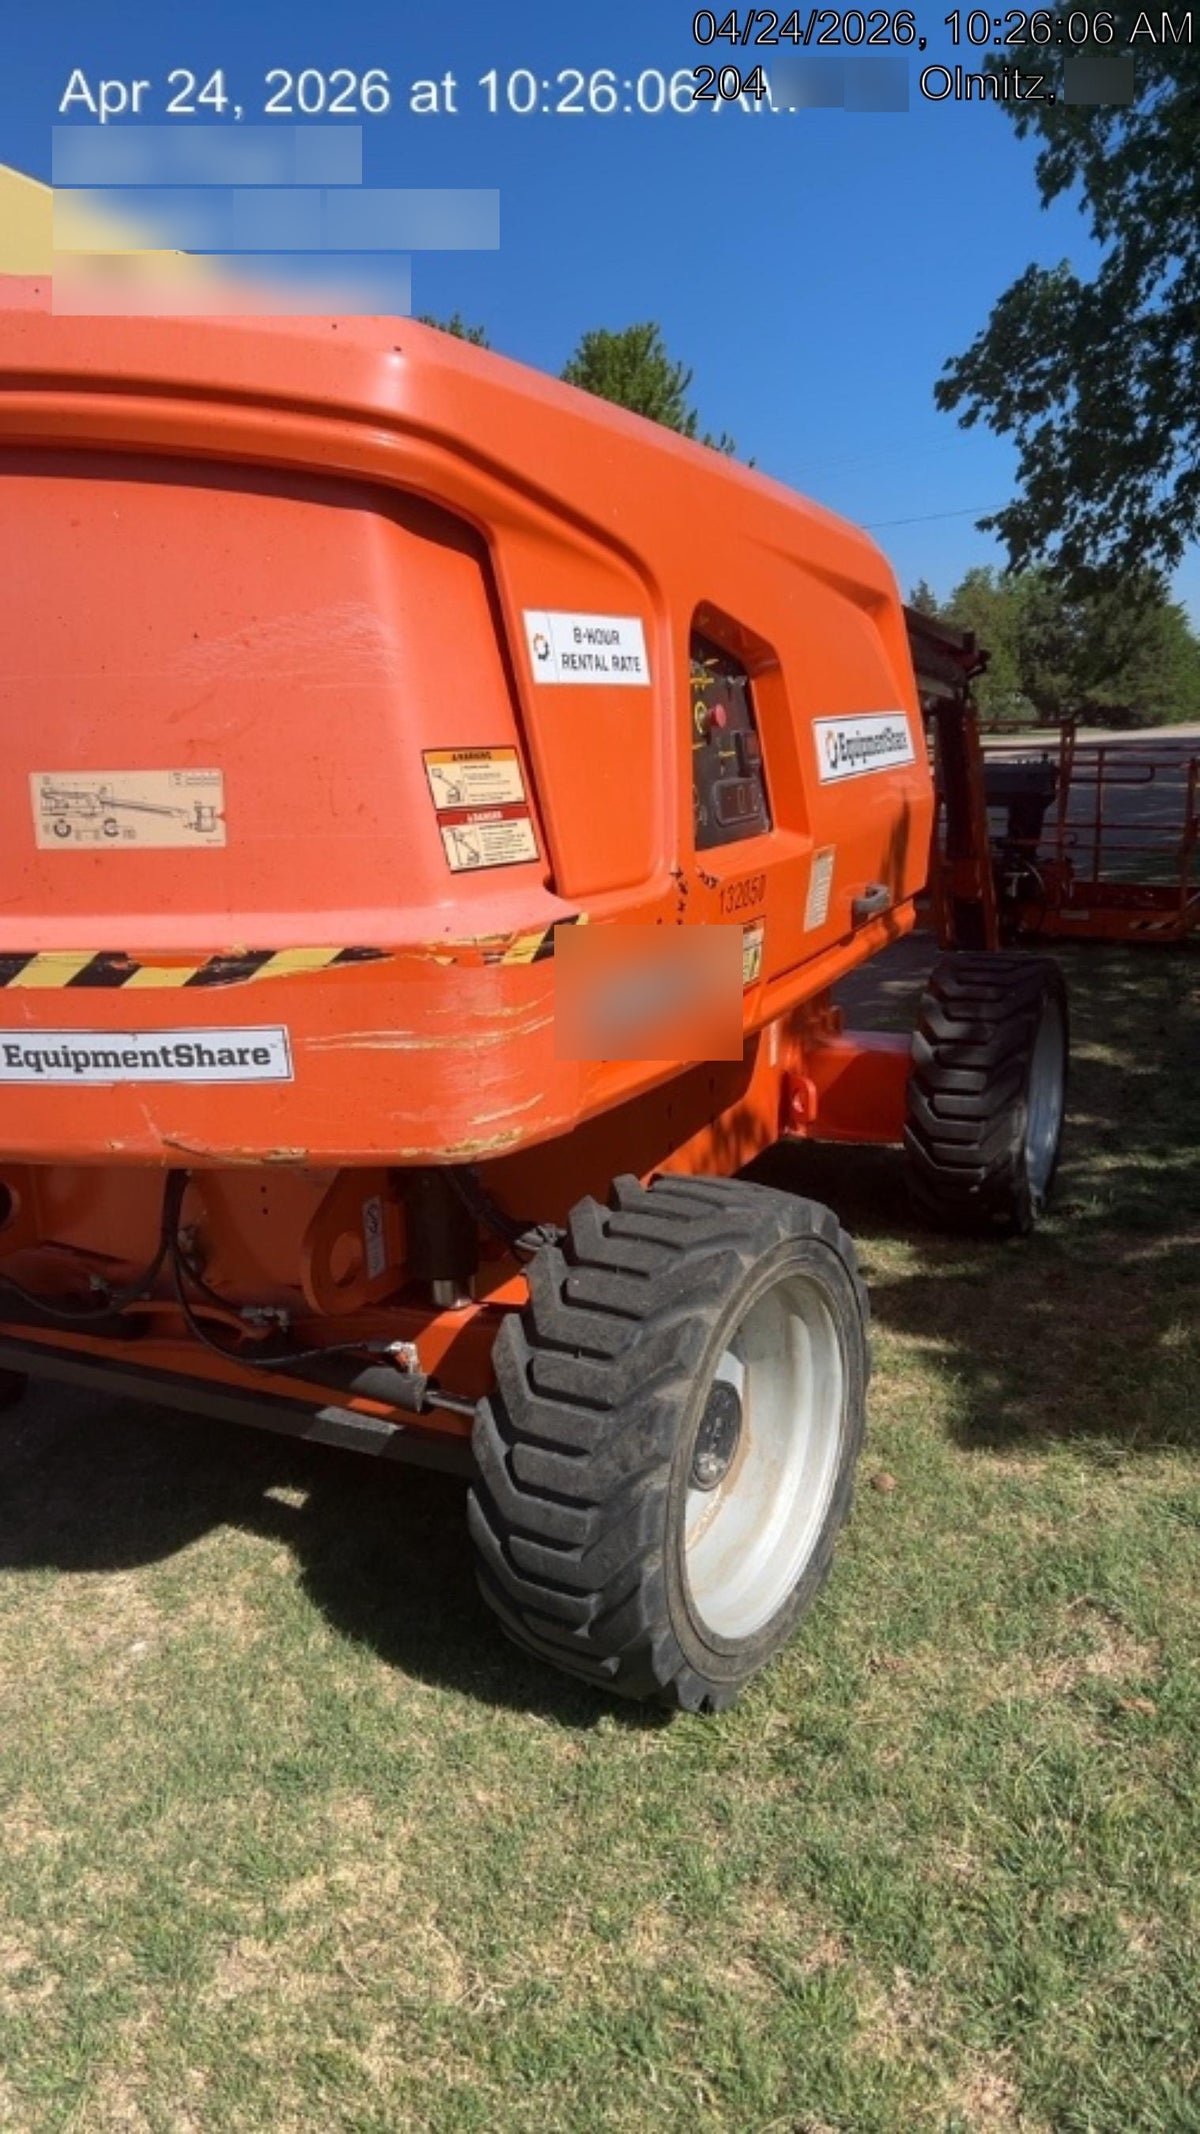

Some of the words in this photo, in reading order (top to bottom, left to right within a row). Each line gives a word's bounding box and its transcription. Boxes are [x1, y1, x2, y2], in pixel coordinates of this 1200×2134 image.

[562, 654, 610, 672] RENTAL
[611, 656, 642, 673] RATE
[2, 1043, 272, 1073] EquipmentShare
